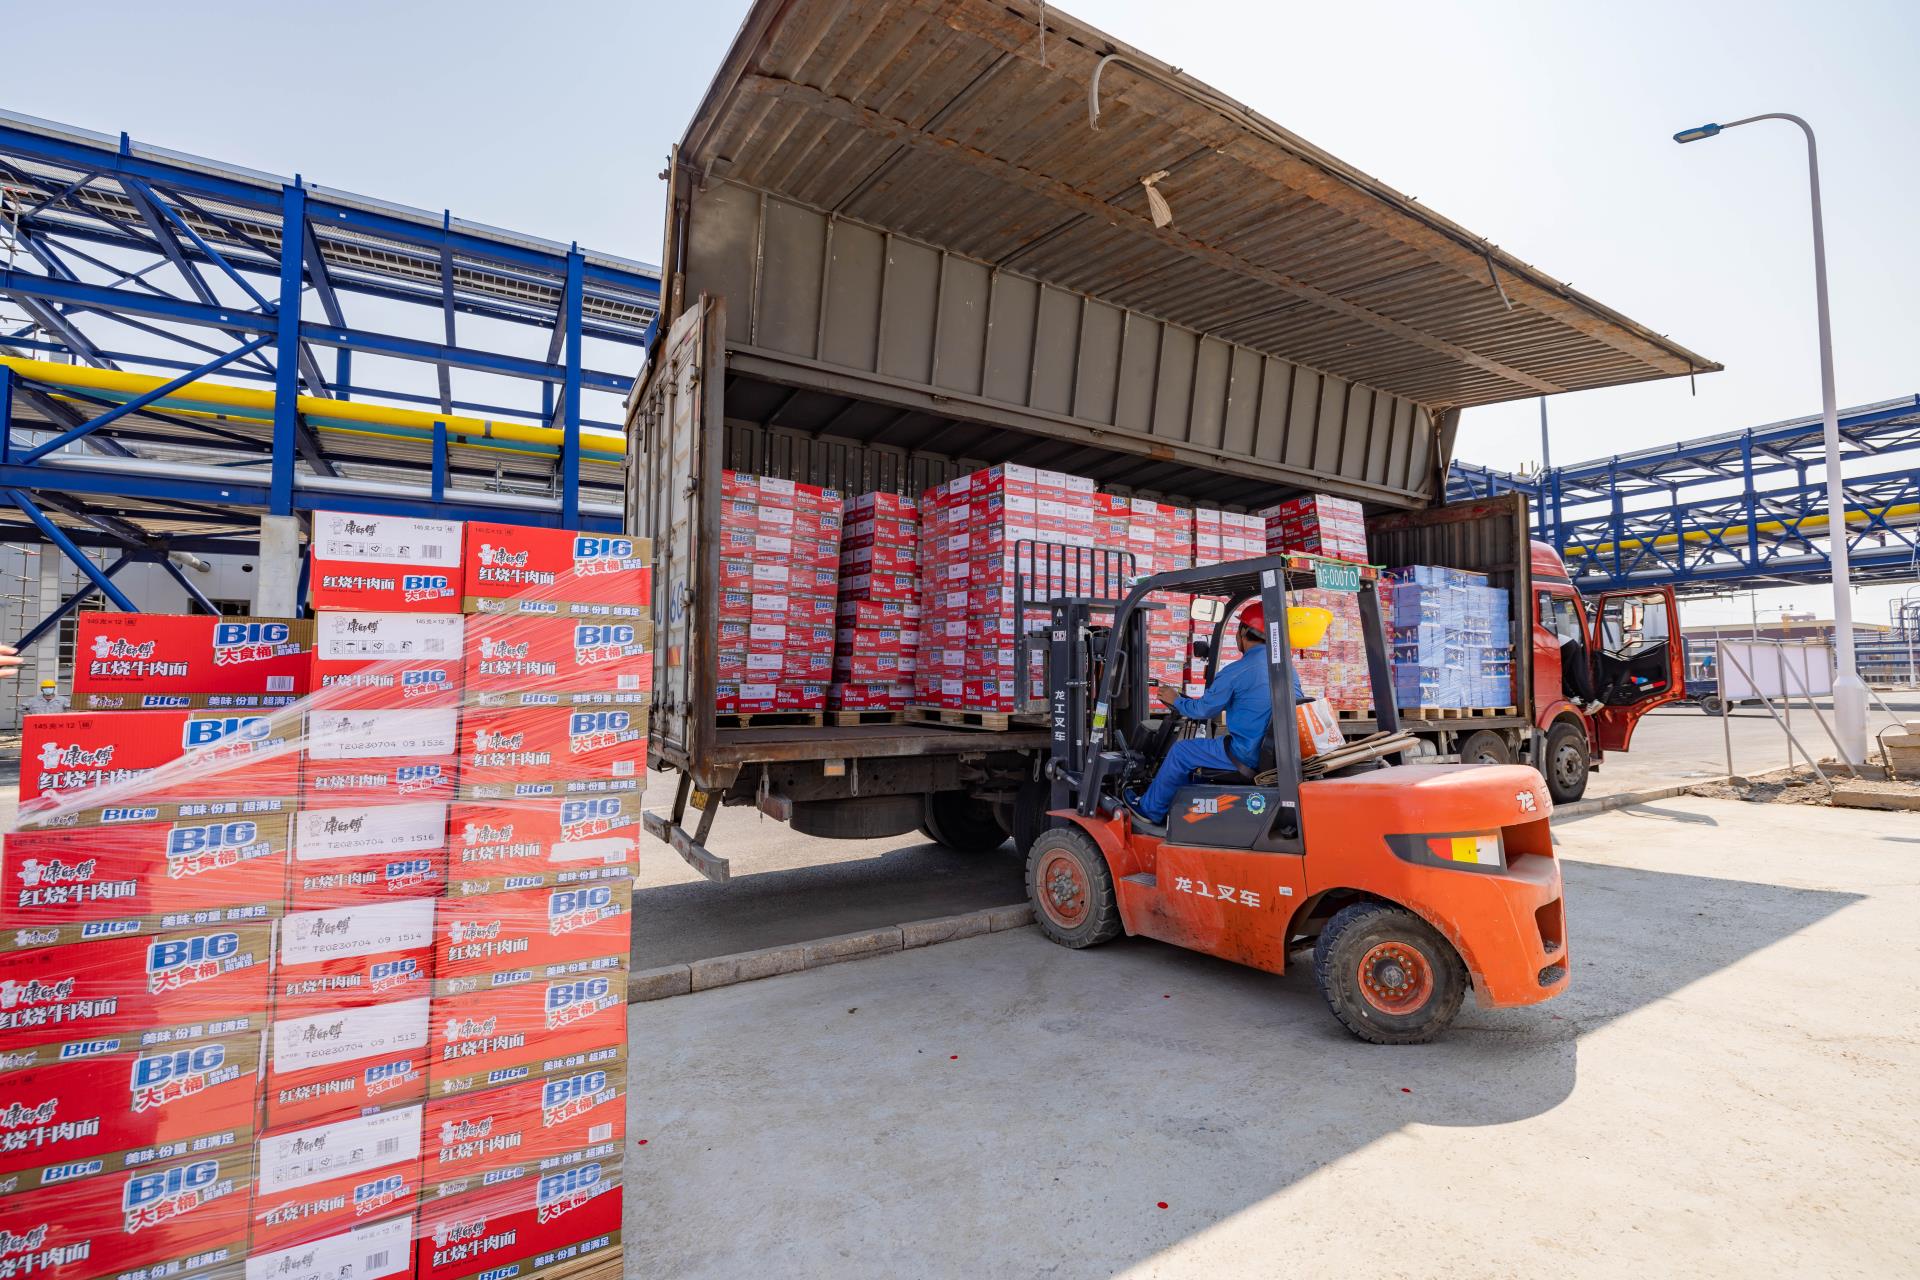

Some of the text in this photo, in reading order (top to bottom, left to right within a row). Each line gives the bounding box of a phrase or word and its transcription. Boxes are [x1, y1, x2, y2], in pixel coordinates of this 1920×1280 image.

[345, 520, 377, 536] 康師傅
[494, 548, 528, 566] 康師傅
[575, 538, 632, 557] BIG
[479, 568, 555, 585] 红烧牛肉面
[578, 560, 620, 575] 大食桶
[323, 576, 395, 590] 红烧牛肉面
[404, 576, 447, 590] BIG
[215, 624, 288, 645] BIG
[348, 618, 379, 633] 康師傅
[576, 626, 633, 647] BIG
[112, 639, 155, 658] 康師傅
[218, 646, 272, 664] 大食桶
[90, 661, 189, 676] 红烧牛肉面
[403, 671, 446, 685] BIG
[480, 661, 556, 675] 红烧牛肉面
[323, 675, 394, 687] 红烧牛肉面
[144, 696, 190, 706] BIG桶
[572, 712, 628, 734] BIG
[1054, 690, 1066, 741] 龙工叉车
[339, 742, 396, 750] T20230704
[489, 731, 523, 749] 康師傅
[574, 733, 616, 752] 大食桶
[64, 745, 113, 766] 康師傅
[474, 752, 550, 767] 红烧牛肉面
[316, 775, 388, 789] 红烧牛肉面
[397, 764, 441, 782] BIG
[242, 801, 282, 812] 超满足
[562, 799, 620, 824] BIG
[1192, 798, 1218, 814] 30
[324, 816, 363, 835] 康師傅
[478, 825, 513, 842] 康師傅
[565, 821, 608, 841] 大食桶
[169, 823, 256, 857] BIG
[328, 839, 384, 848] T20230704
[175, 850, 238, 875] 大食桶
[462, 843, 541, 863] 红烧牛肉面
[43, 860, 95, 881] 康師傅
[387, 859, 431, 878] BIG
[304, 871, 377, 890] 红烧牛肉面
[18, 879, 137, 907] 红烧牛肉面
[550, 887, 610, 917] BIG
[1175, 876, 1261, 907] 龙工叉车
[226, 906, 268, 919] 超满足
[553, 911, 598, 935] 大食桶
[83, 921, 141, 937] BIG桶
[463, 921, 500, 939] 康師傅
[151, 934, 239, 972] BIG
[313, 940, 371, 952] T20230704
[398, 933, 422, 942] 1514
[448, 937, 528, 961] 红烧牛肉面
[154, 962, 219, 993] 大食桶
[371, 960, 416, 982] BIG
[22, 979, 74, 1003] 康師傅
[286, 973, 362, 997] 红烧牛肉面
[546, 978, 608, 1011] BIG
[0, 997, 118, 1030] 红烧牛肉面
[549, 1002, 595, 1028] 大食桶
[208, 1019, 249, 1034] 超满足
[303, 1020, 343, 1042] 康師傅
[459, 1017, 496, 1038] 康師傅
[61, 1040, 120, 1059] BIG桶
[305, 1042, 363, 1058] T20230704
[371, 1039, 384, 1047] 09
[392, 1032, 417, 1043] 1515
[444, 1033, 525, 1060] 红烧牛肉面
[134, 1045, 224, 1090] BIG
[365, 1060, 411, 1085] BIG
[489, 1068, 529, 1083] BIG桶
[138, 1076, 204, 1110] 大食桶
[280, 1076, 355, 1104] 红烧牛肉面
[544, 1071, 605, 1109] BIG
[2, 1099, 57, 1127] 康師傅
[0, 1117, 100, 1151] 烧牛肉面
[456, 1116, 493, 1138] 康師傅
[192, 1133, 236, 1150] 超满足
[439, 1132, 522, 1163] 红烧牛肉面
[43, 1160, 103, 1183] BIG桶
[126, 1160, 218, 1211] BIG
[355, 1175, 402, 1203] BIG
[538, 1163, 601, 1206] BIG
[129, 1192, 199, 1232] 大食桶
[266, 1195, 345, 1227] 红烧牛肉面
[540, 1191, 587, 1224] 大食桶
[450, 1218, 486, 1241] 康師傅
[432, 1229, 516, 1267] 红烧牛肉面
